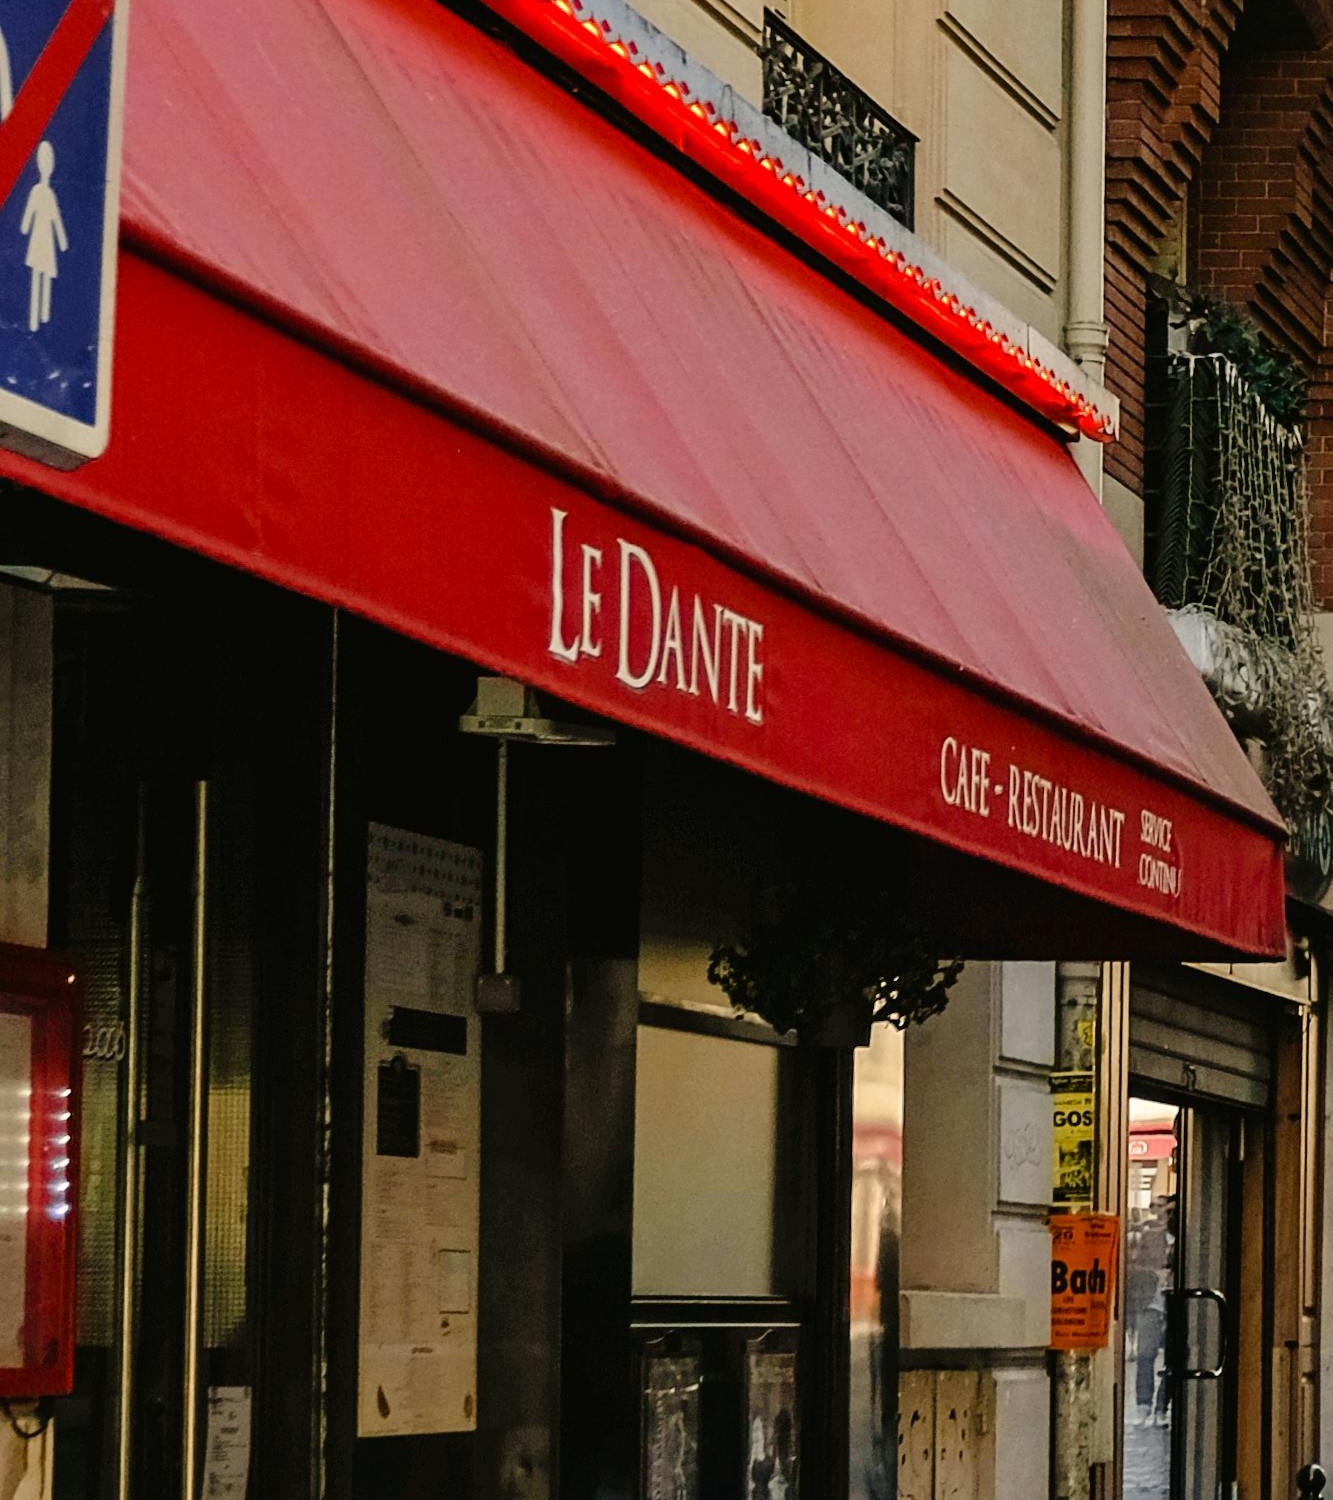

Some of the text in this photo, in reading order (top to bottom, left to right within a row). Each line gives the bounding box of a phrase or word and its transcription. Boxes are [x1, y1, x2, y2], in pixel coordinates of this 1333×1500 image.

[941, 737, 991, 818] CAFE
[1008, 764, 1125, 869] RESTAURANT
[1141, 809, 1173, 853] SERVICE
[1138, 852, 1182, 898] CONTINU
